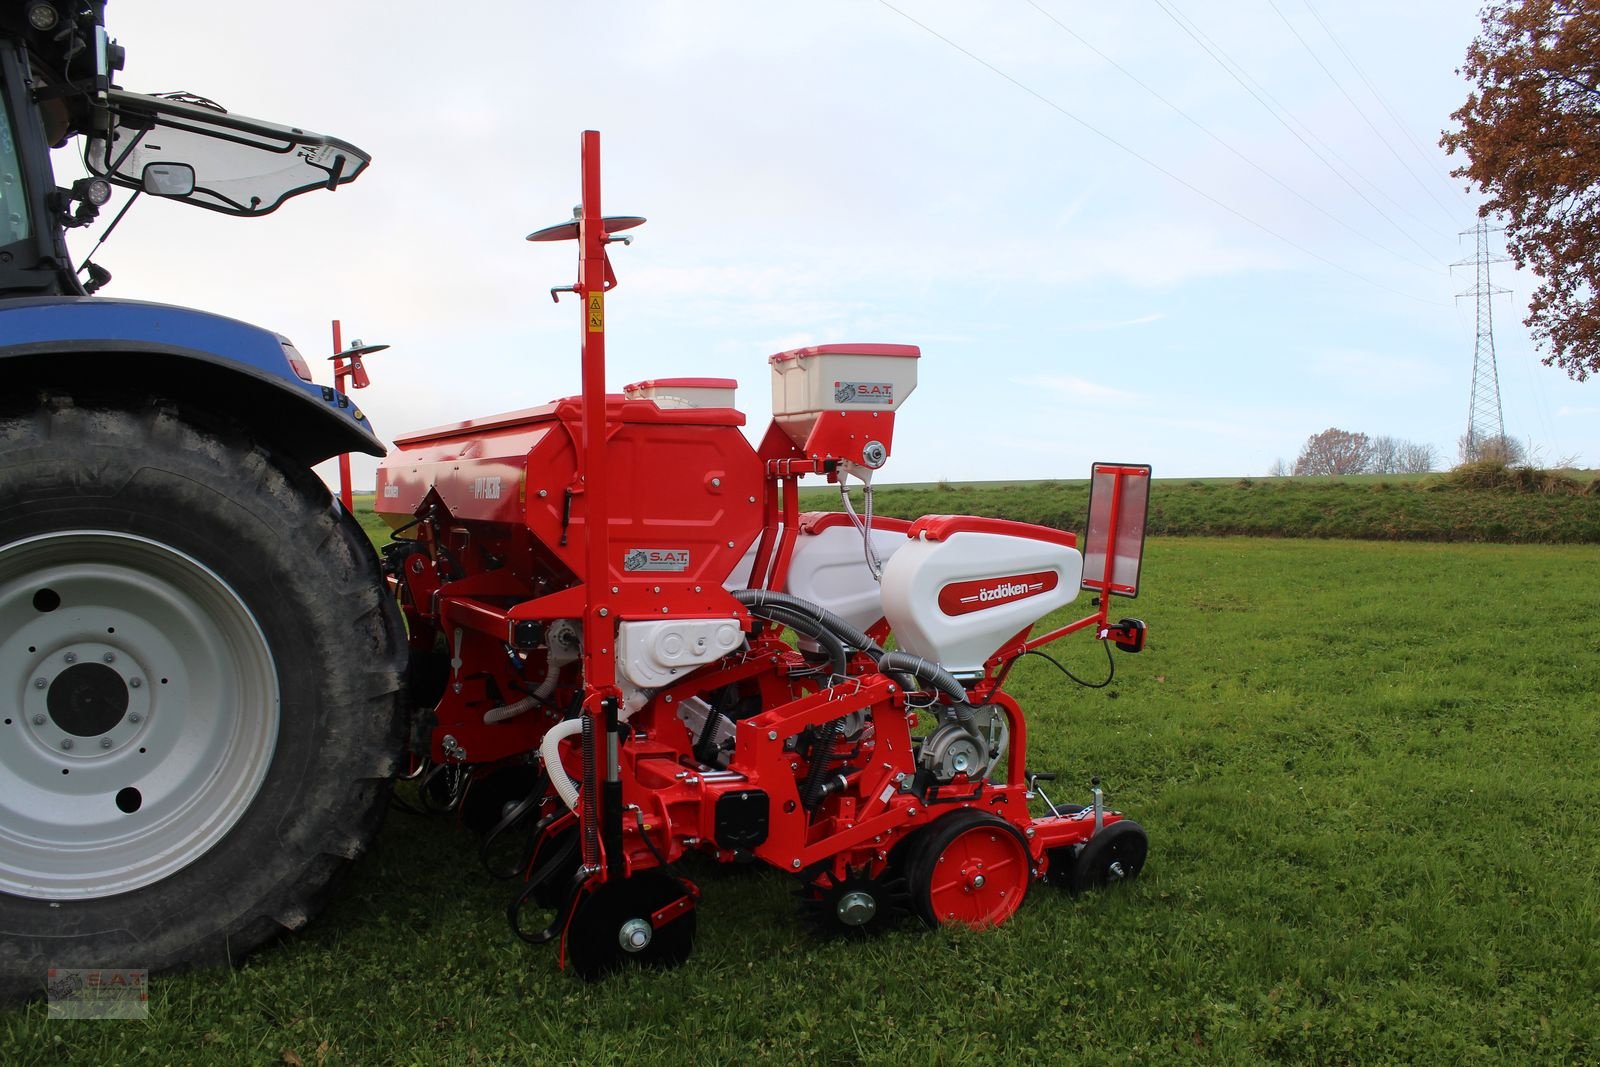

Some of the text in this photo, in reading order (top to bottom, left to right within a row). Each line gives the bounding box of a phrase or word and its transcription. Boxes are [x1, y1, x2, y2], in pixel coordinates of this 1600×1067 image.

[857, 385, 892, 394] S.A.T.
[650, 552, 688, 561] S.A.T.
[979, 583, 1028, 602] özdöken
